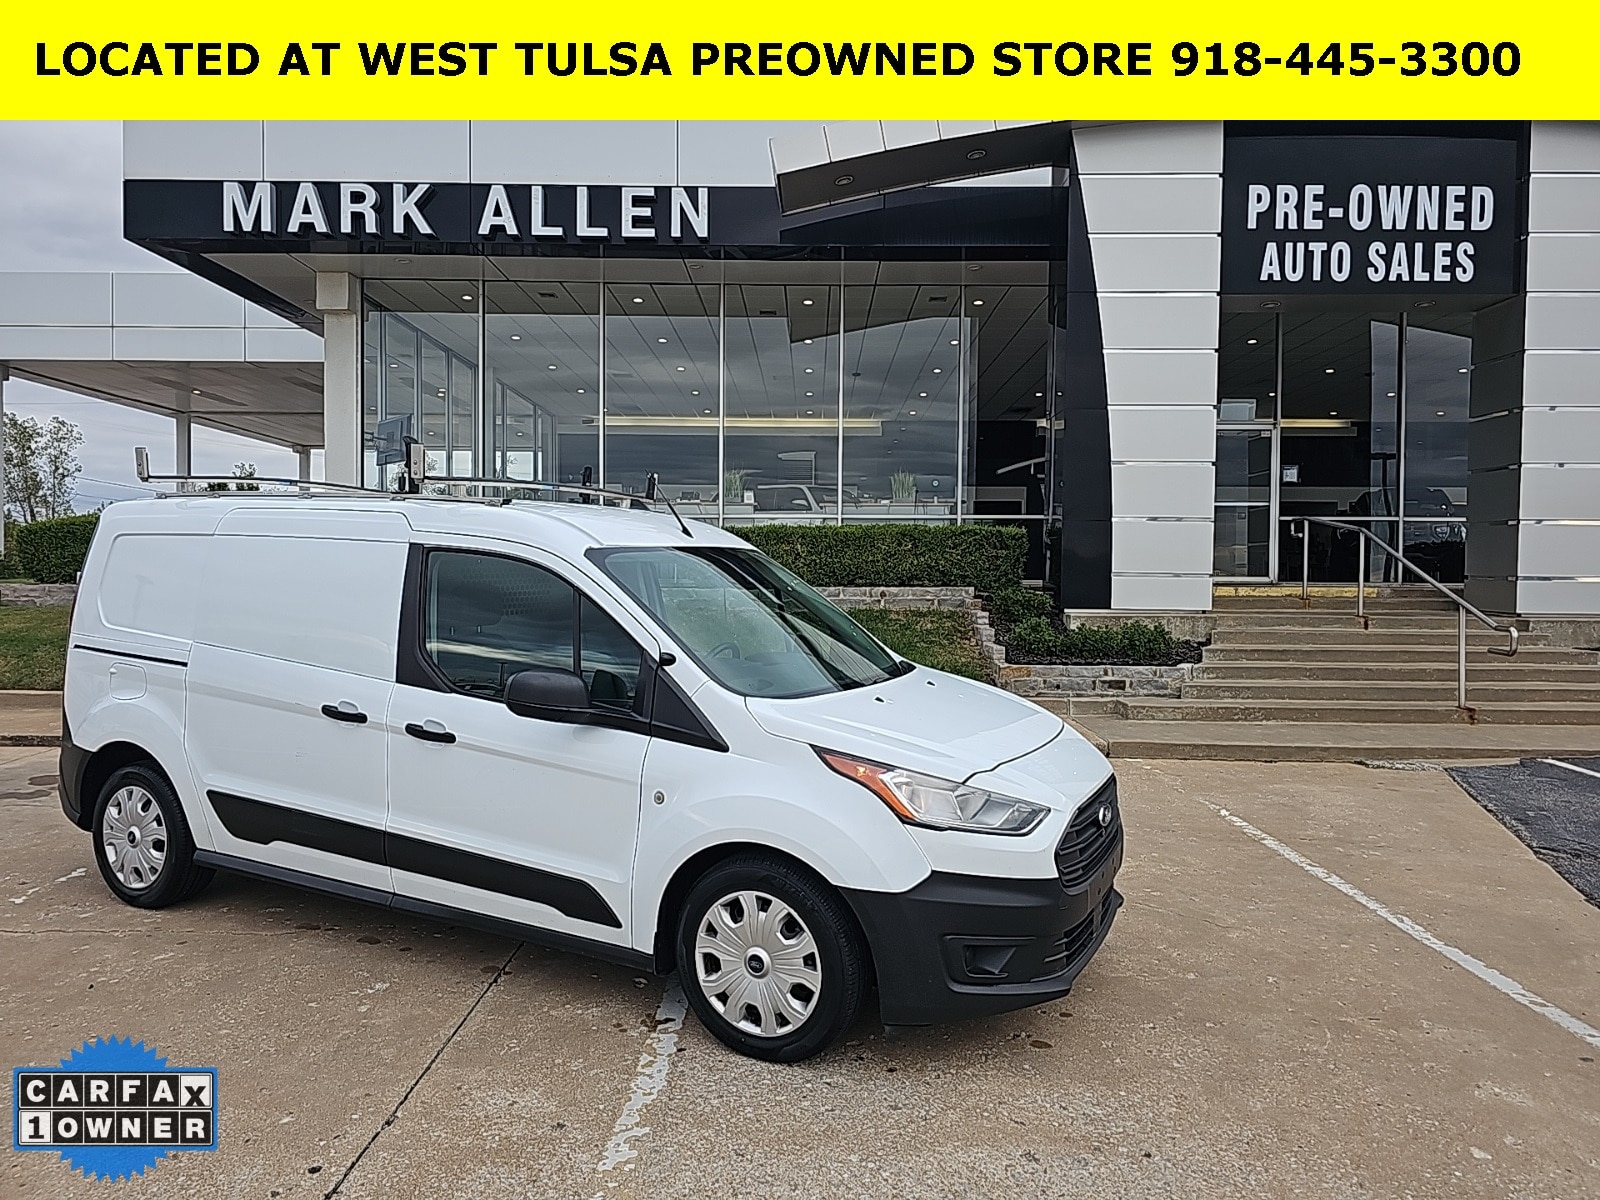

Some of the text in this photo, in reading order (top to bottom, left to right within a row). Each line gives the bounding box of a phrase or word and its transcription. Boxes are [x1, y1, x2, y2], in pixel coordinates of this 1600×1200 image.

[223, 181, 710, 239] MARK ALLEN
[1247, 184, 1494, 231] PRE-OWNED
[1260, 241, 1475, 283] AUTO SALES
